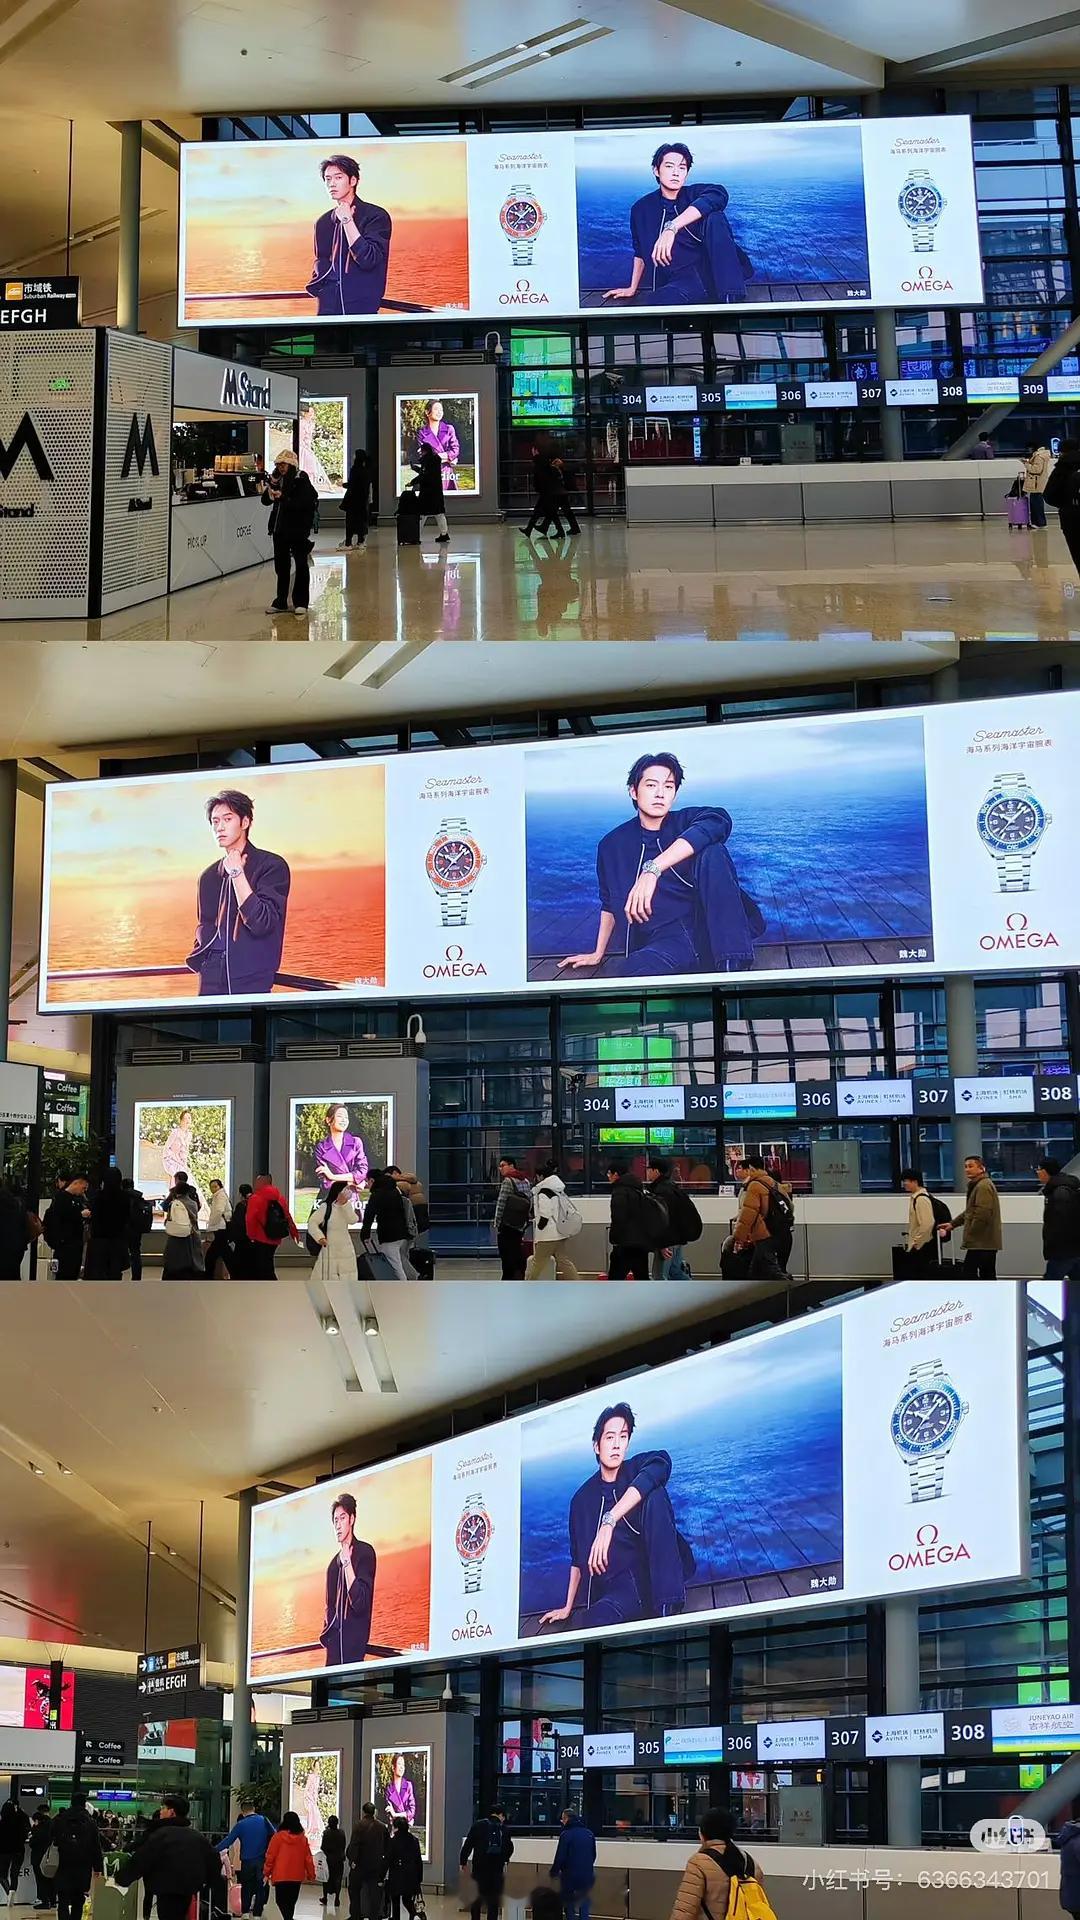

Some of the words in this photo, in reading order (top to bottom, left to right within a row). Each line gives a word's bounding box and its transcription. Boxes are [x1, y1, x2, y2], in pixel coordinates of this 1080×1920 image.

[24, 283, 52, 293] 市域铁
[901, 281, 953, 292] OMEGA
[499, 293, 550, 304] OMEGA
[1, 309, 47, 324] EFGH
[780, 391, 801, 401] 306
[861, 388, 882, 398] 307
[942, 386, 963, 396] 308
[1023, 384, 1044, 395] 309
[622, 395, 642, 405] 304
[701, 393, 721, 402] 305
[973, 726, 1044, 742] Seamaster
[425, 775, 483, 789] Seamaster
[980, 932, 1059, 950] OMEGA
[423, 963, 487, 978] OMEGA
[57, 1083, 78, 1093] Coffee
[1040, 1086, 1072, 1102] 308
[690, 1095, 718, 1109] 305
[802, 1093, 831, 1106] 306
[919, 1089, 949, 1104] 307
[56, 1103, 77, 1113] Coffee
[583, 1099, 610, 1111] 304
[890, 1300, 964, 1333] Seamaster
[883, 1312, 973, 1348] 海马系列海洋宇宙腕表
[888, 1543, 971, 1571] OMEGA
[451, 1624, 493, 1641] OMEGA
[166, 1674, 187, 1690] EFGH
[831, 1730, 859, 1746] 307
[951, 1724, 985, 1740] 308
[98, 1742, 122, 1750] Coffee
[638, 1741, 660, 1754] 305
[727, 1736, 752, 1750] 306
[560, 1745, 580, 1758] 304
[97, 1756, 121, 1764] Coffee
